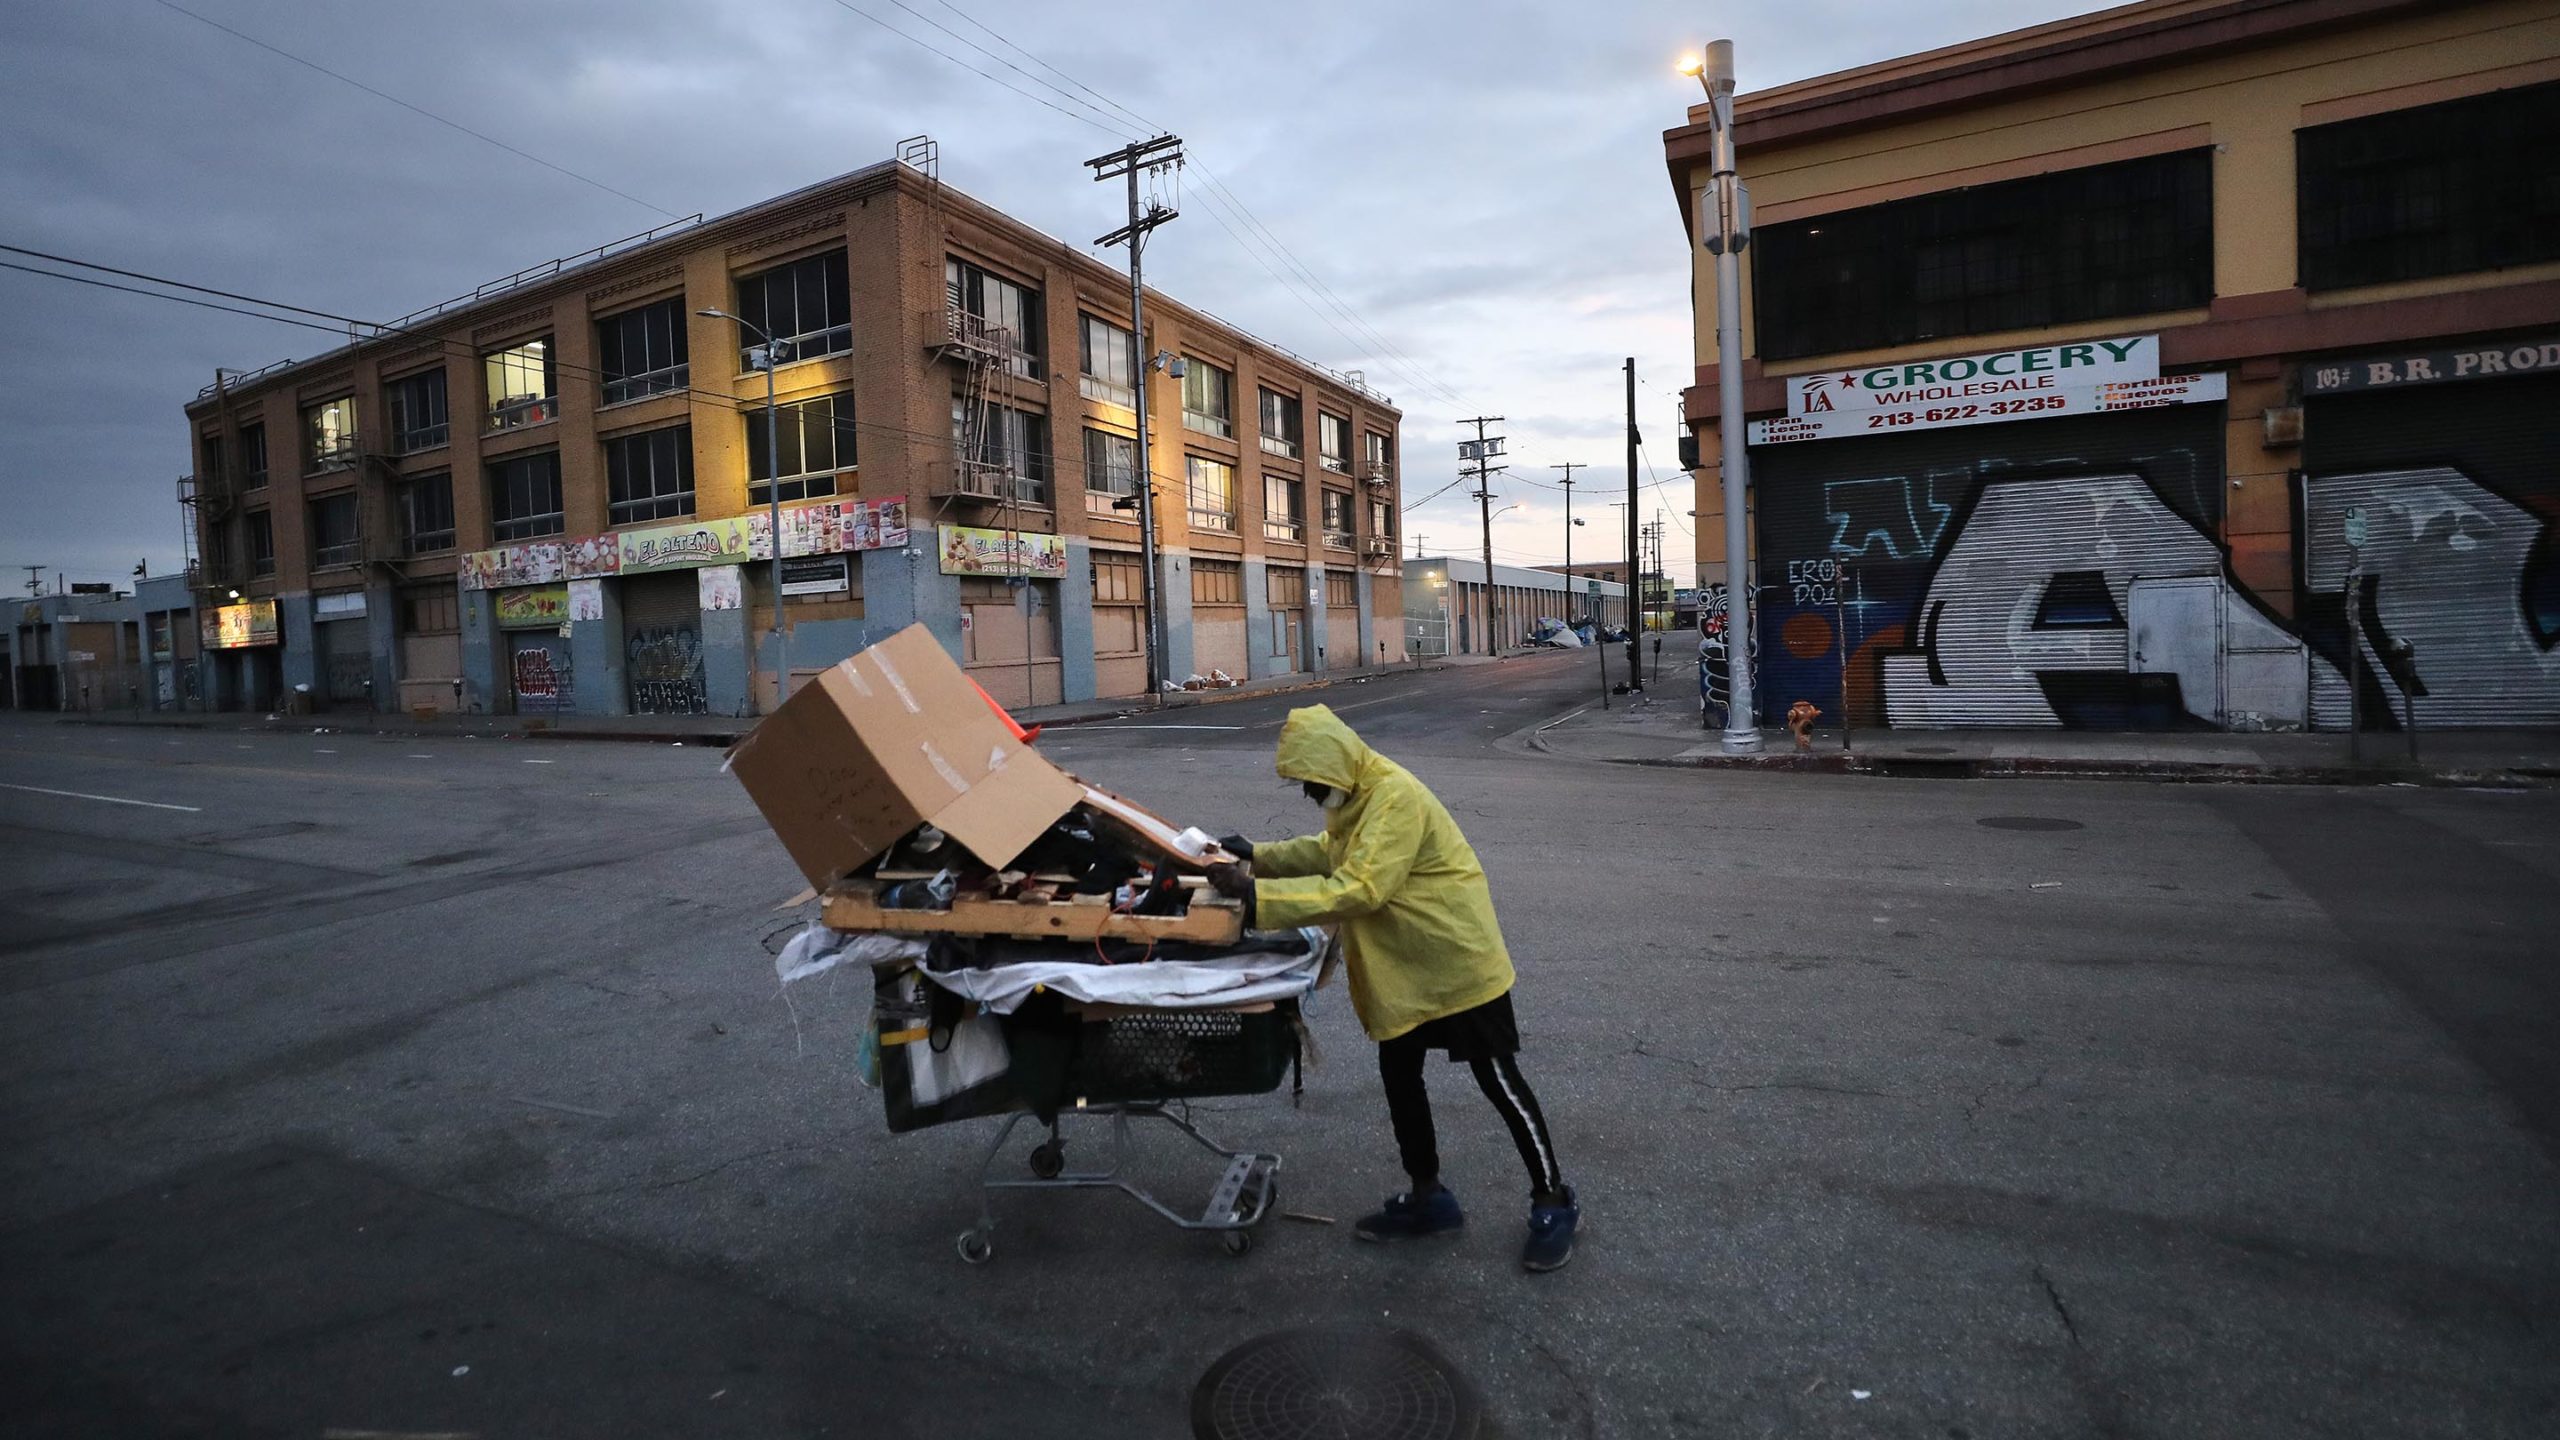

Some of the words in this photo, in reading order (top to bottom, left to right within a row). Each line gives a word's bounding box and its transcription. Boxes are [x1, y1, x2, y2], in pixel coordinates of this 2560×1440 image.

[1863, 338, 2142, 390] GROCERY
[2367, 358, 2441, 385] B.R.
[1875, 375, 2055, 405] WHOLESALE
[2104, 374, 2201, 391] Tortillas
[2105, 387, 2189, 401] Huevos
[1868, 395, 2066, 428] 213-622-3235
[2104, 398, 2169, 411] Jugos
[1769, 417, 1802, 426] Pan
[1769, 423, 1823, 434] Leche
[1769, 432, 1816, 443] Hielo
[640, 540, 658, 561] EL
[975, 539, 990, 557] EL
[982, 565, 999, 574] (213)
